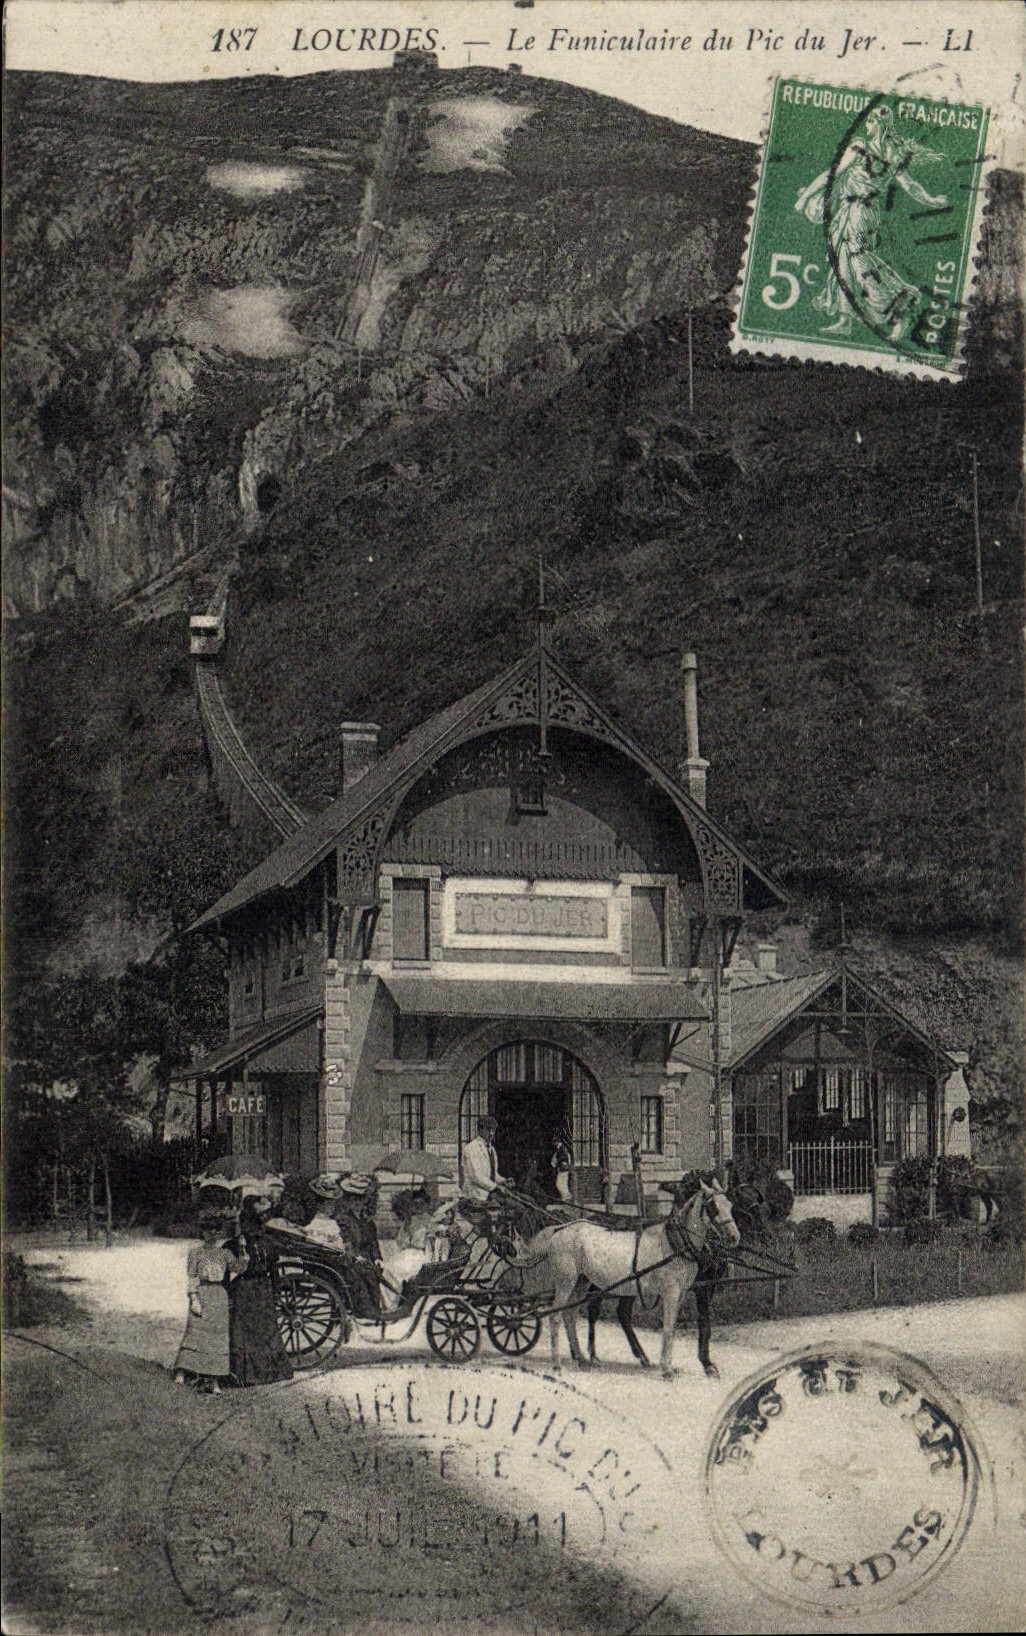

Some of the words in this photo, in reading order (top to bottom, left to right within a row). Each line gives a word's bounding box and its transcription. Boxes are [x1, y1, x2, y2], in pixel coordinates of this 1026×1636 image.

[471, 903, 507, 925] PIC
[516, 907, 546, 925] DU
[553, 906, 593, 927] JER
